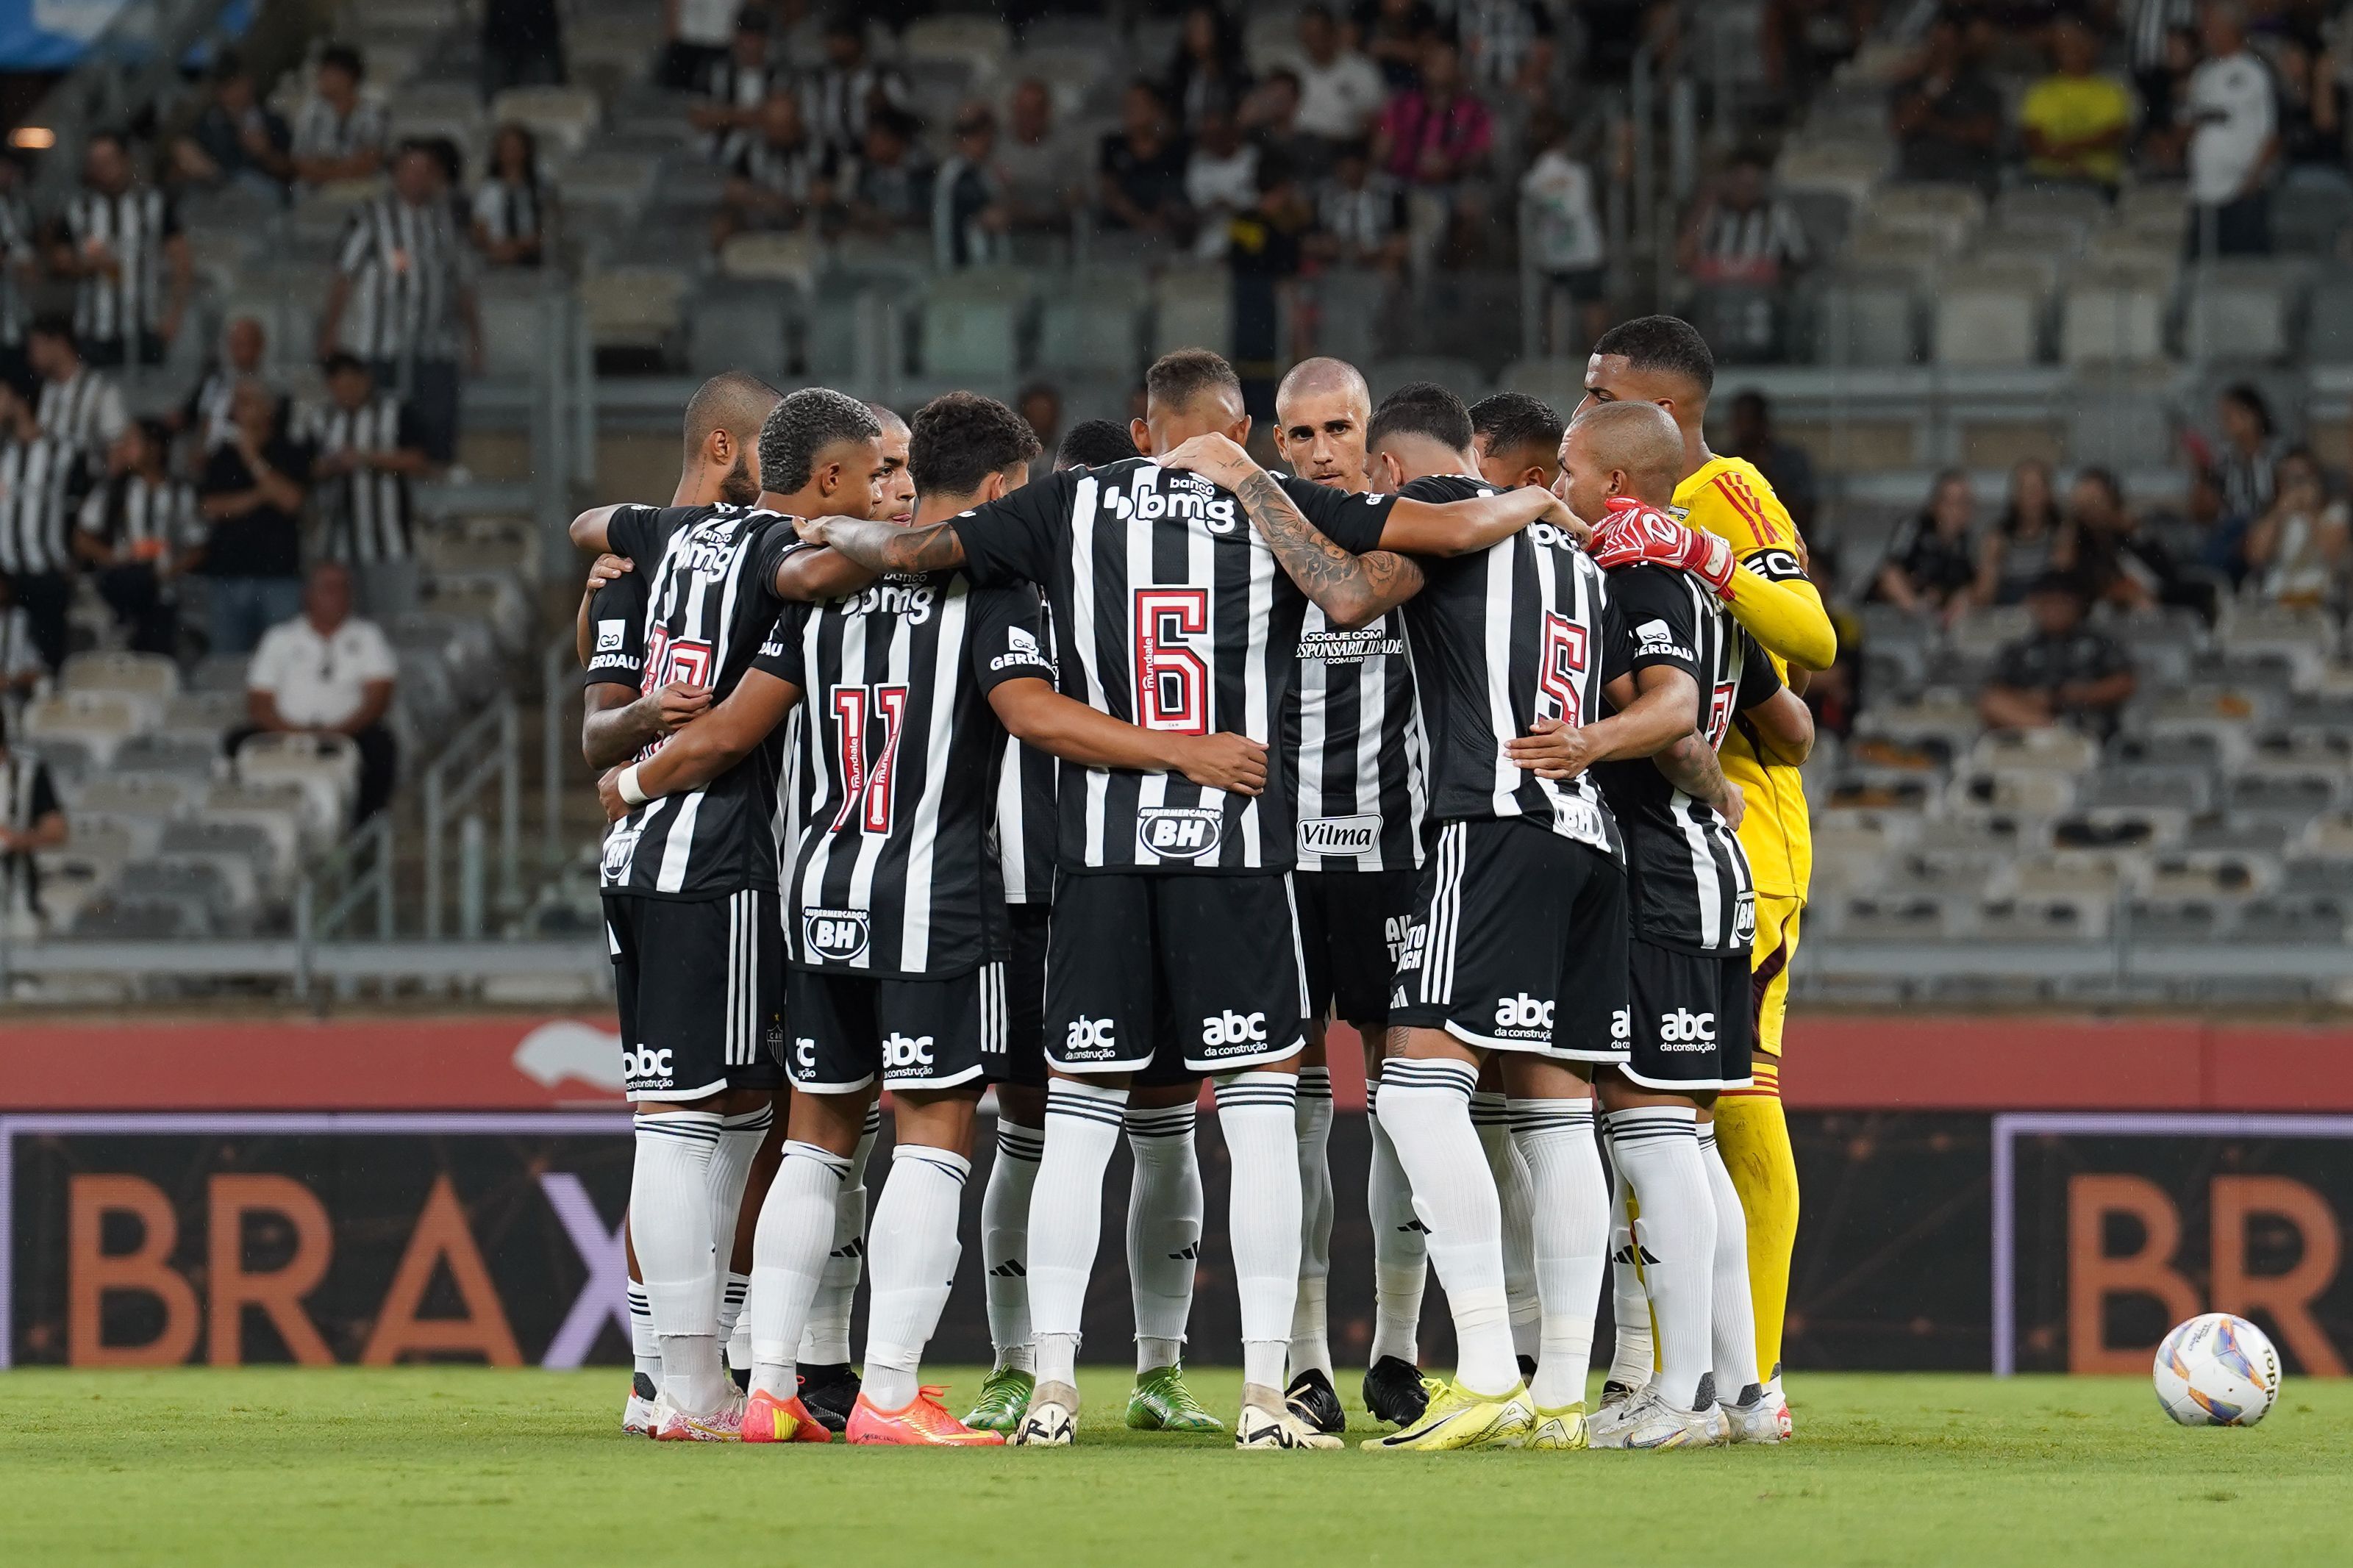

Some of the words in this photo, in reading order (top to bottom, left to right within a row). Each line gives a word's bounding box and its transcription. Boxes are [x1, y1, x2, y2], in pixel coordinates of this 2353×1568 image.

[1169, 477, 1215, 495] banco
[1138, 485, 1236, 534] bmg
[1296, 639, 1404, 658] SPONSABILIDADE
[1306, 632, 1351, 642] JOGUE
[1352, 631, 1382, 640] COM
[588, 654, 640, 670] ERDAU
[1133, 587, 1209, 734] 6
[1142, 637, 1154, 690] mundiale
[1633, 643, 1693, 662] ERDAU
[849, 737, 861, 789] mundiale
[1151, 819, 1206, 847] BH
[1303, 823, 1372, 845] Vilma
[815, 920, 857, 948] BH
[1495, 992, 1555, 1029] abc
[1660, 1007, 1715, 1041] abc
[1066, 1014, 1115, 1049] abc
[1202, 1009, 1267, 1045] abc
[1494, 1027, 1507, 1037] da
[1204, 1047, 1218, 1056] da
[1218, 1041, 1268, 1053] construção
[1660, 1042, 1672, 1051] da
[1673, 1041, 1717, 1053] construção
